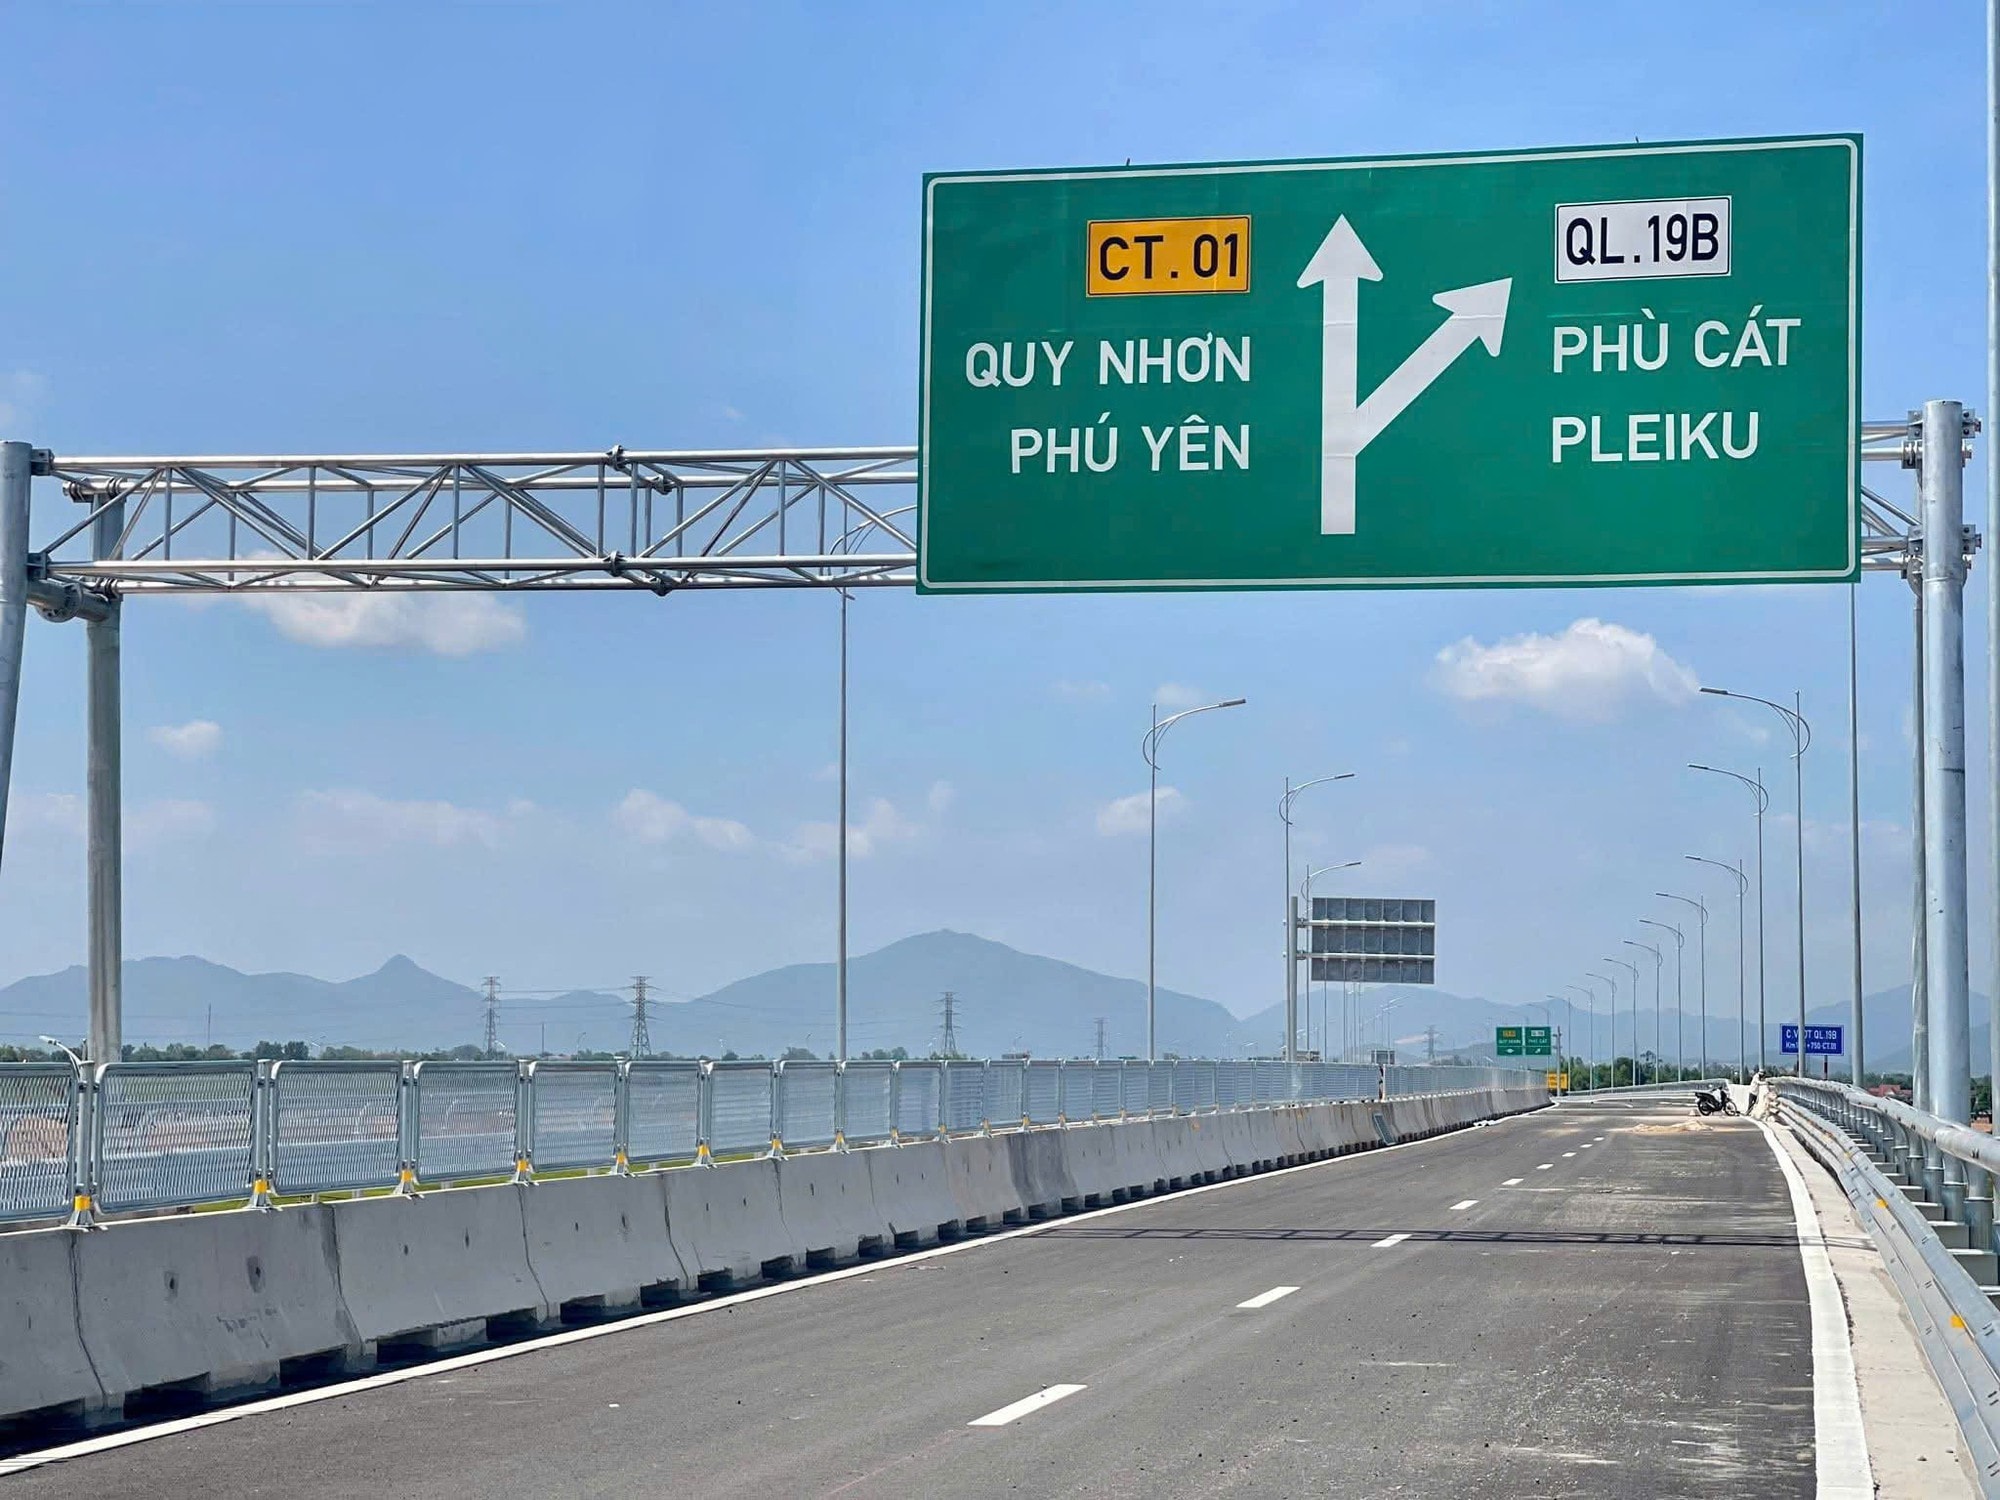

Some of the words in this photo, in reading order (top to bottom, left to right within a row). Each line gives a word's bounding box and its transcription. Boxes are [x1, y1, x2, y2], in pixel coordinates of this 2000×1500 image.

[1566, 213, 1719, 266] QL.19B
[966, 340, 1074, 388] QUY
[1099, 331, 1251, 385] NHƠN
[1553, 308, 1669, 373] PHÙ
[1694, 304, 1802, 368] CÁT
[1011, 411, 1118, 474] PHÚ
[1141, 414, 1250, 472] YÊN
[1552, 411, 1759, 463] PLEIKU
